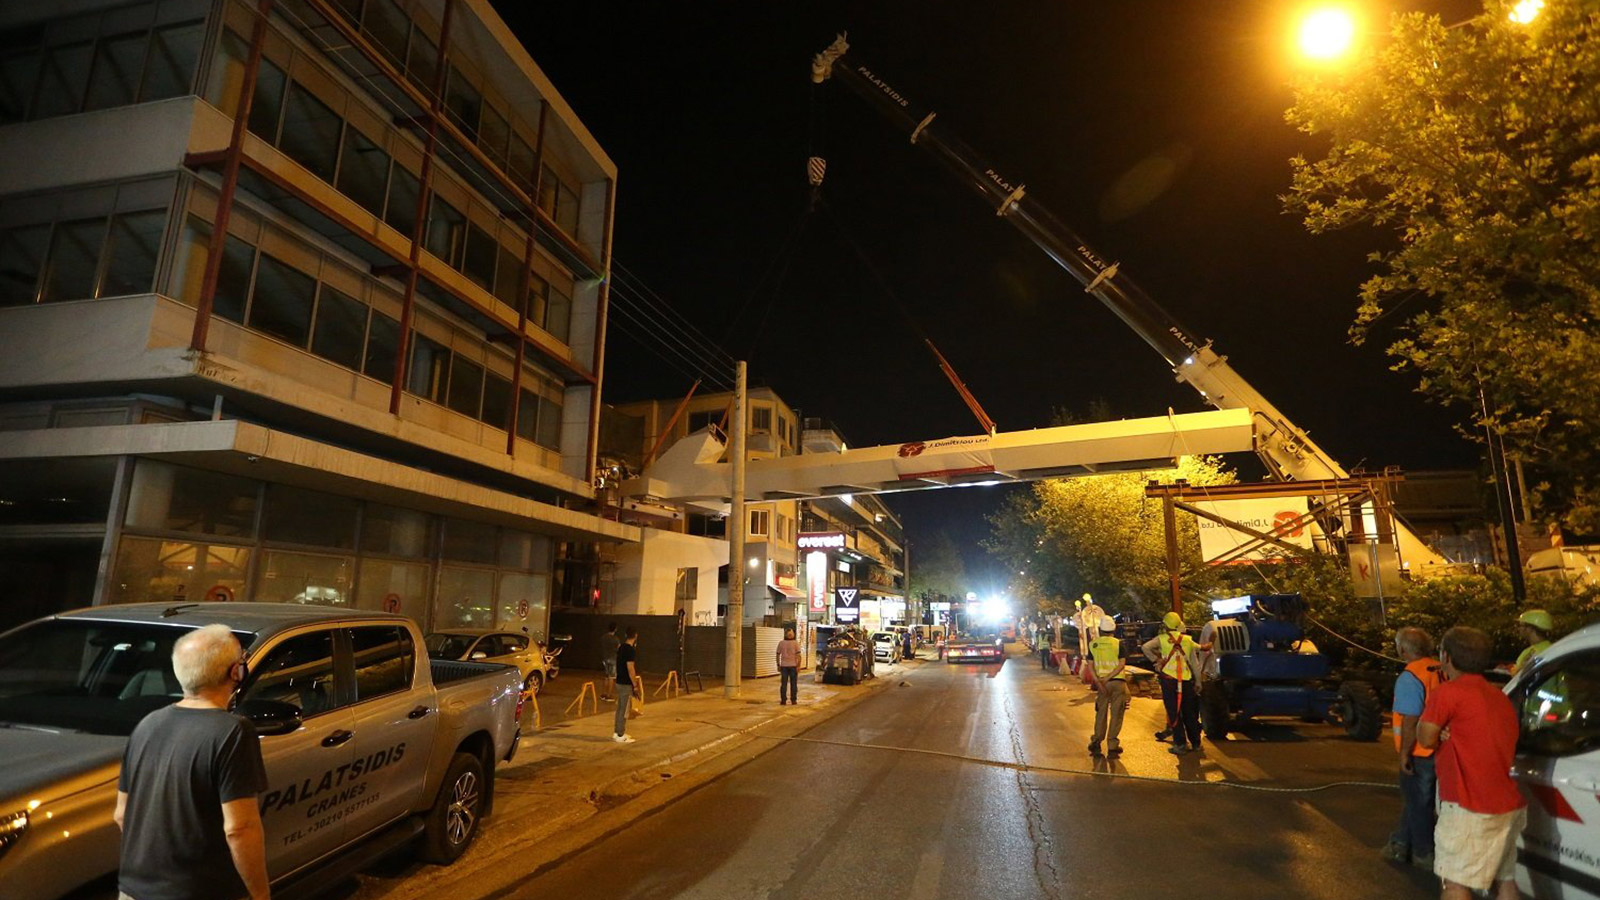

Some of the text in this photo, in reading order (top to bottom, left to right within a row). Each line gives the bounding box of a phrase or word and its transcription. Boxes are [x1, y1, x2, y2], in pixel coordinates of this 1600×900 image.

[857, 66, 909, 107] PALATSIDIS
[985, 169, 1015, 192] PALAT
[1077, 246, 1107, 270] PALAT
[1169, 326, 1198, 352] PALAT
[1358, 563, 1371, 581] K
[260, 742, 406, 817] PALATSIDIS
[306, 782, 367, 818] CRANES
